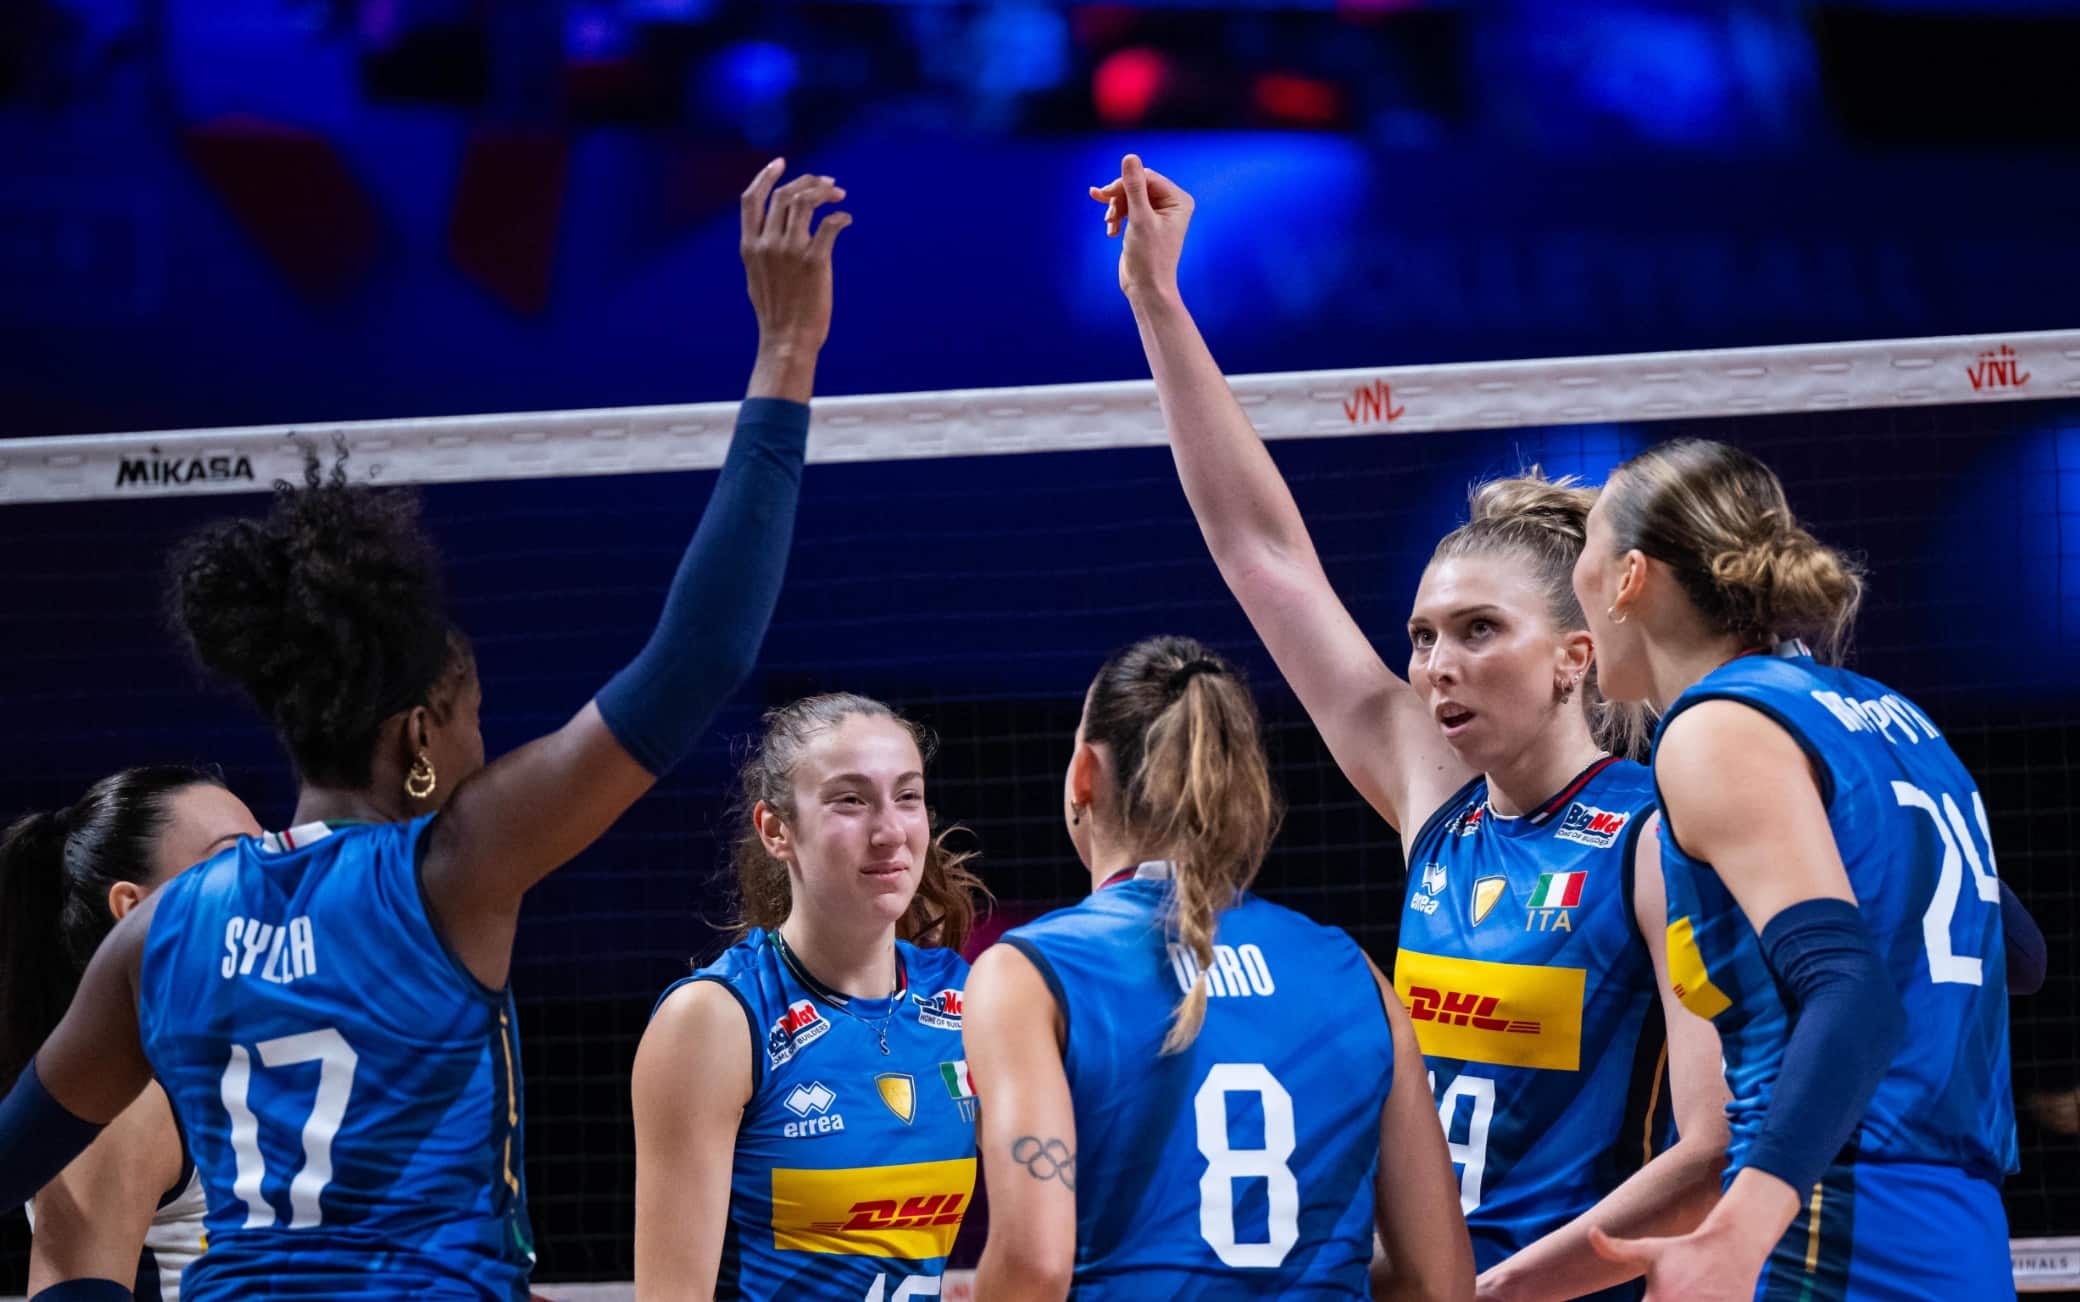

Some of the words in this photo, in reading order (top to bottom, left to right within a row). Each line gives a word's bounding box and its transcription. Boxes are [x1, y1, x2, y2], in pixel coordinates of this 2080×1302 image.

[1965, 343, 2031, 392] VNL
[1343, 378, 1405, 425] VNL
[1525, 910, 1572, 932] ITA
[221, 914, 317, 984] SYLLA
[1408, 985, 1510, 1032] DHL
[220, 1027, 359, 1230] 17
[1428, 1070, 1496, 1217] 9
[1193, 1062, 1300, 1268] 8
[840, 1193, 965, 1232] DHL
[2012, 1256, 2068, 1270] INALS
